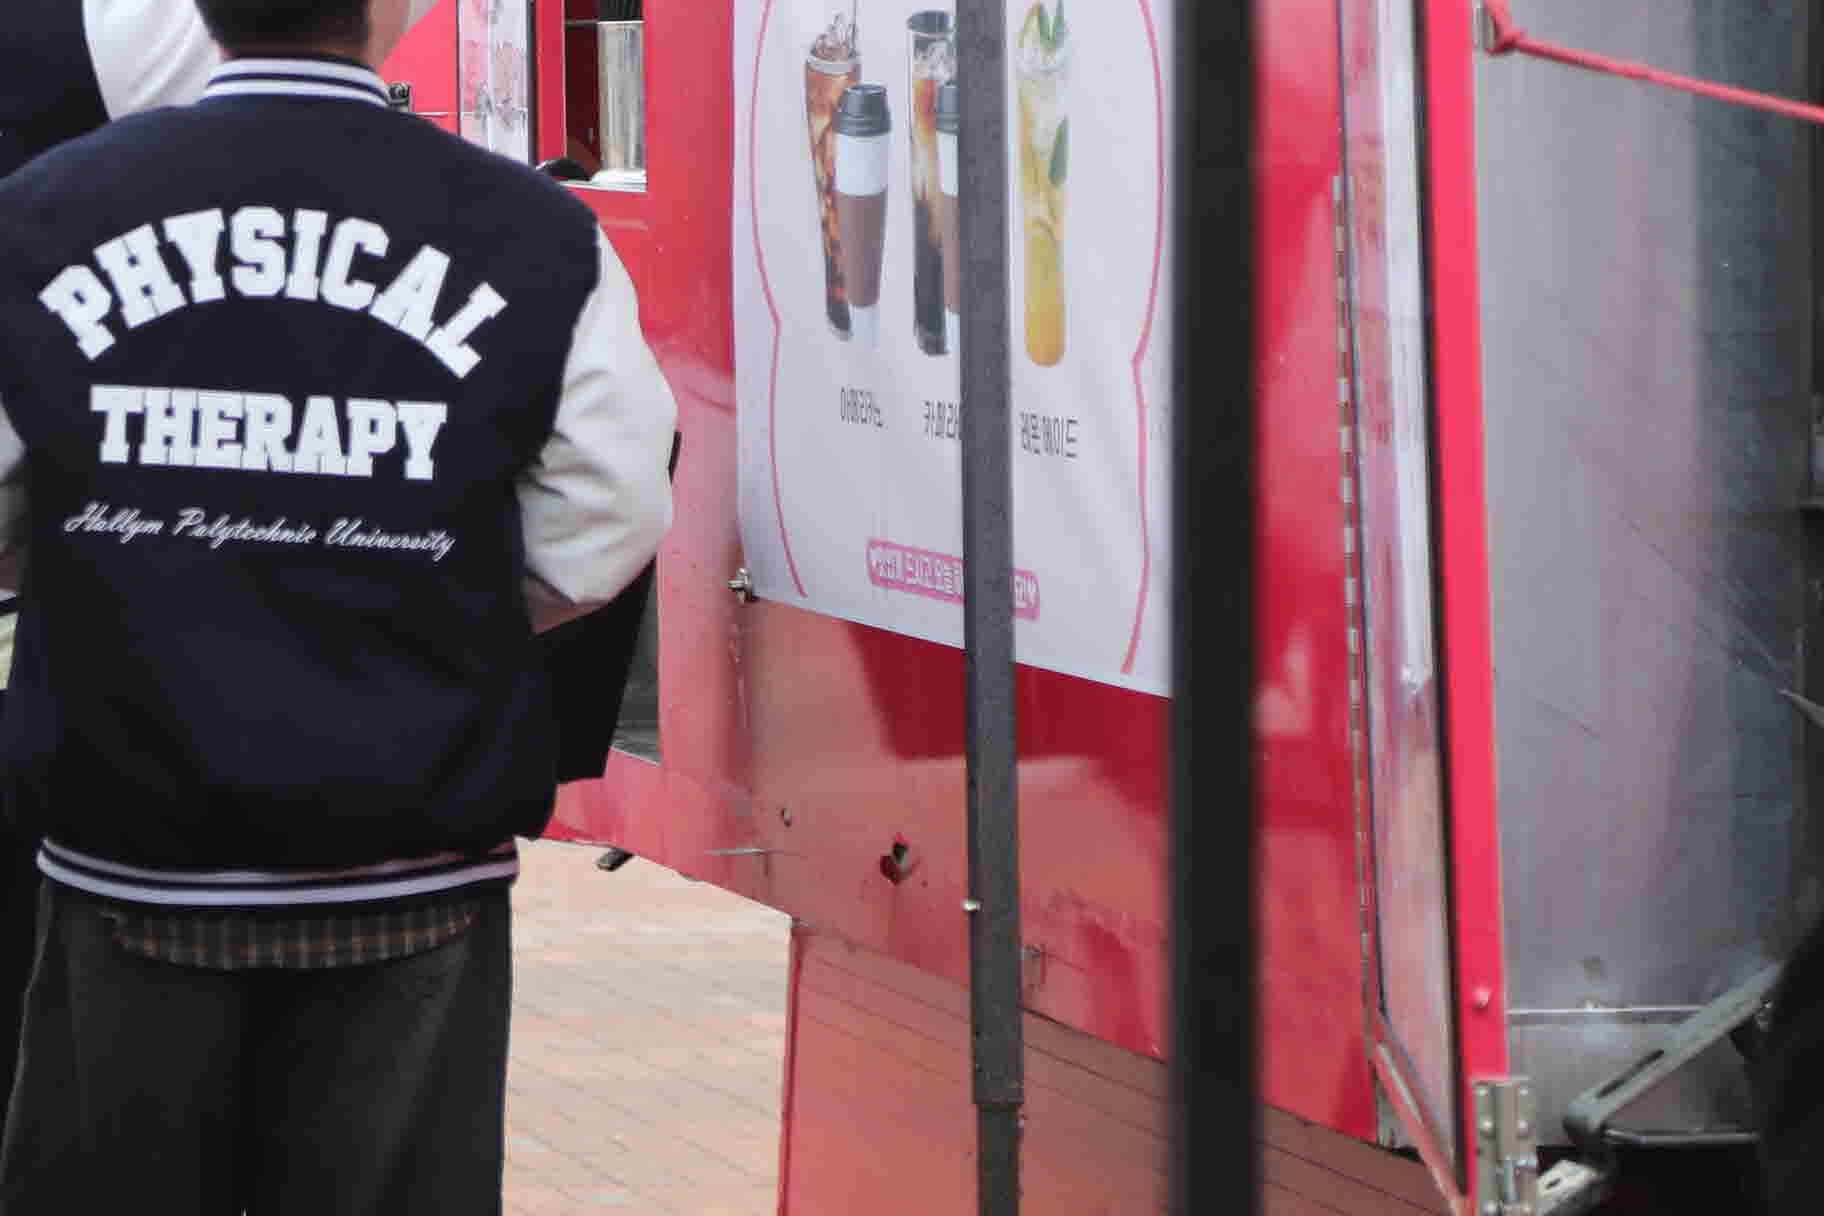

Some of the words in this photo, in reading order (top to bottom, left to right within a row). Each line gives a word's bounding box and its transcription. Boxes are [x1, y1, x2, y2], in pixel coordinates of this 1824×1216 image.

[38, 205, 508, 381] PHYSICAL
[89, 384, 448, 482] THERAPY
[63, 500, 165, 545] Hallym
[172, 506, 318, 550] Polytechnic
[325, 517, 457, 562] University
